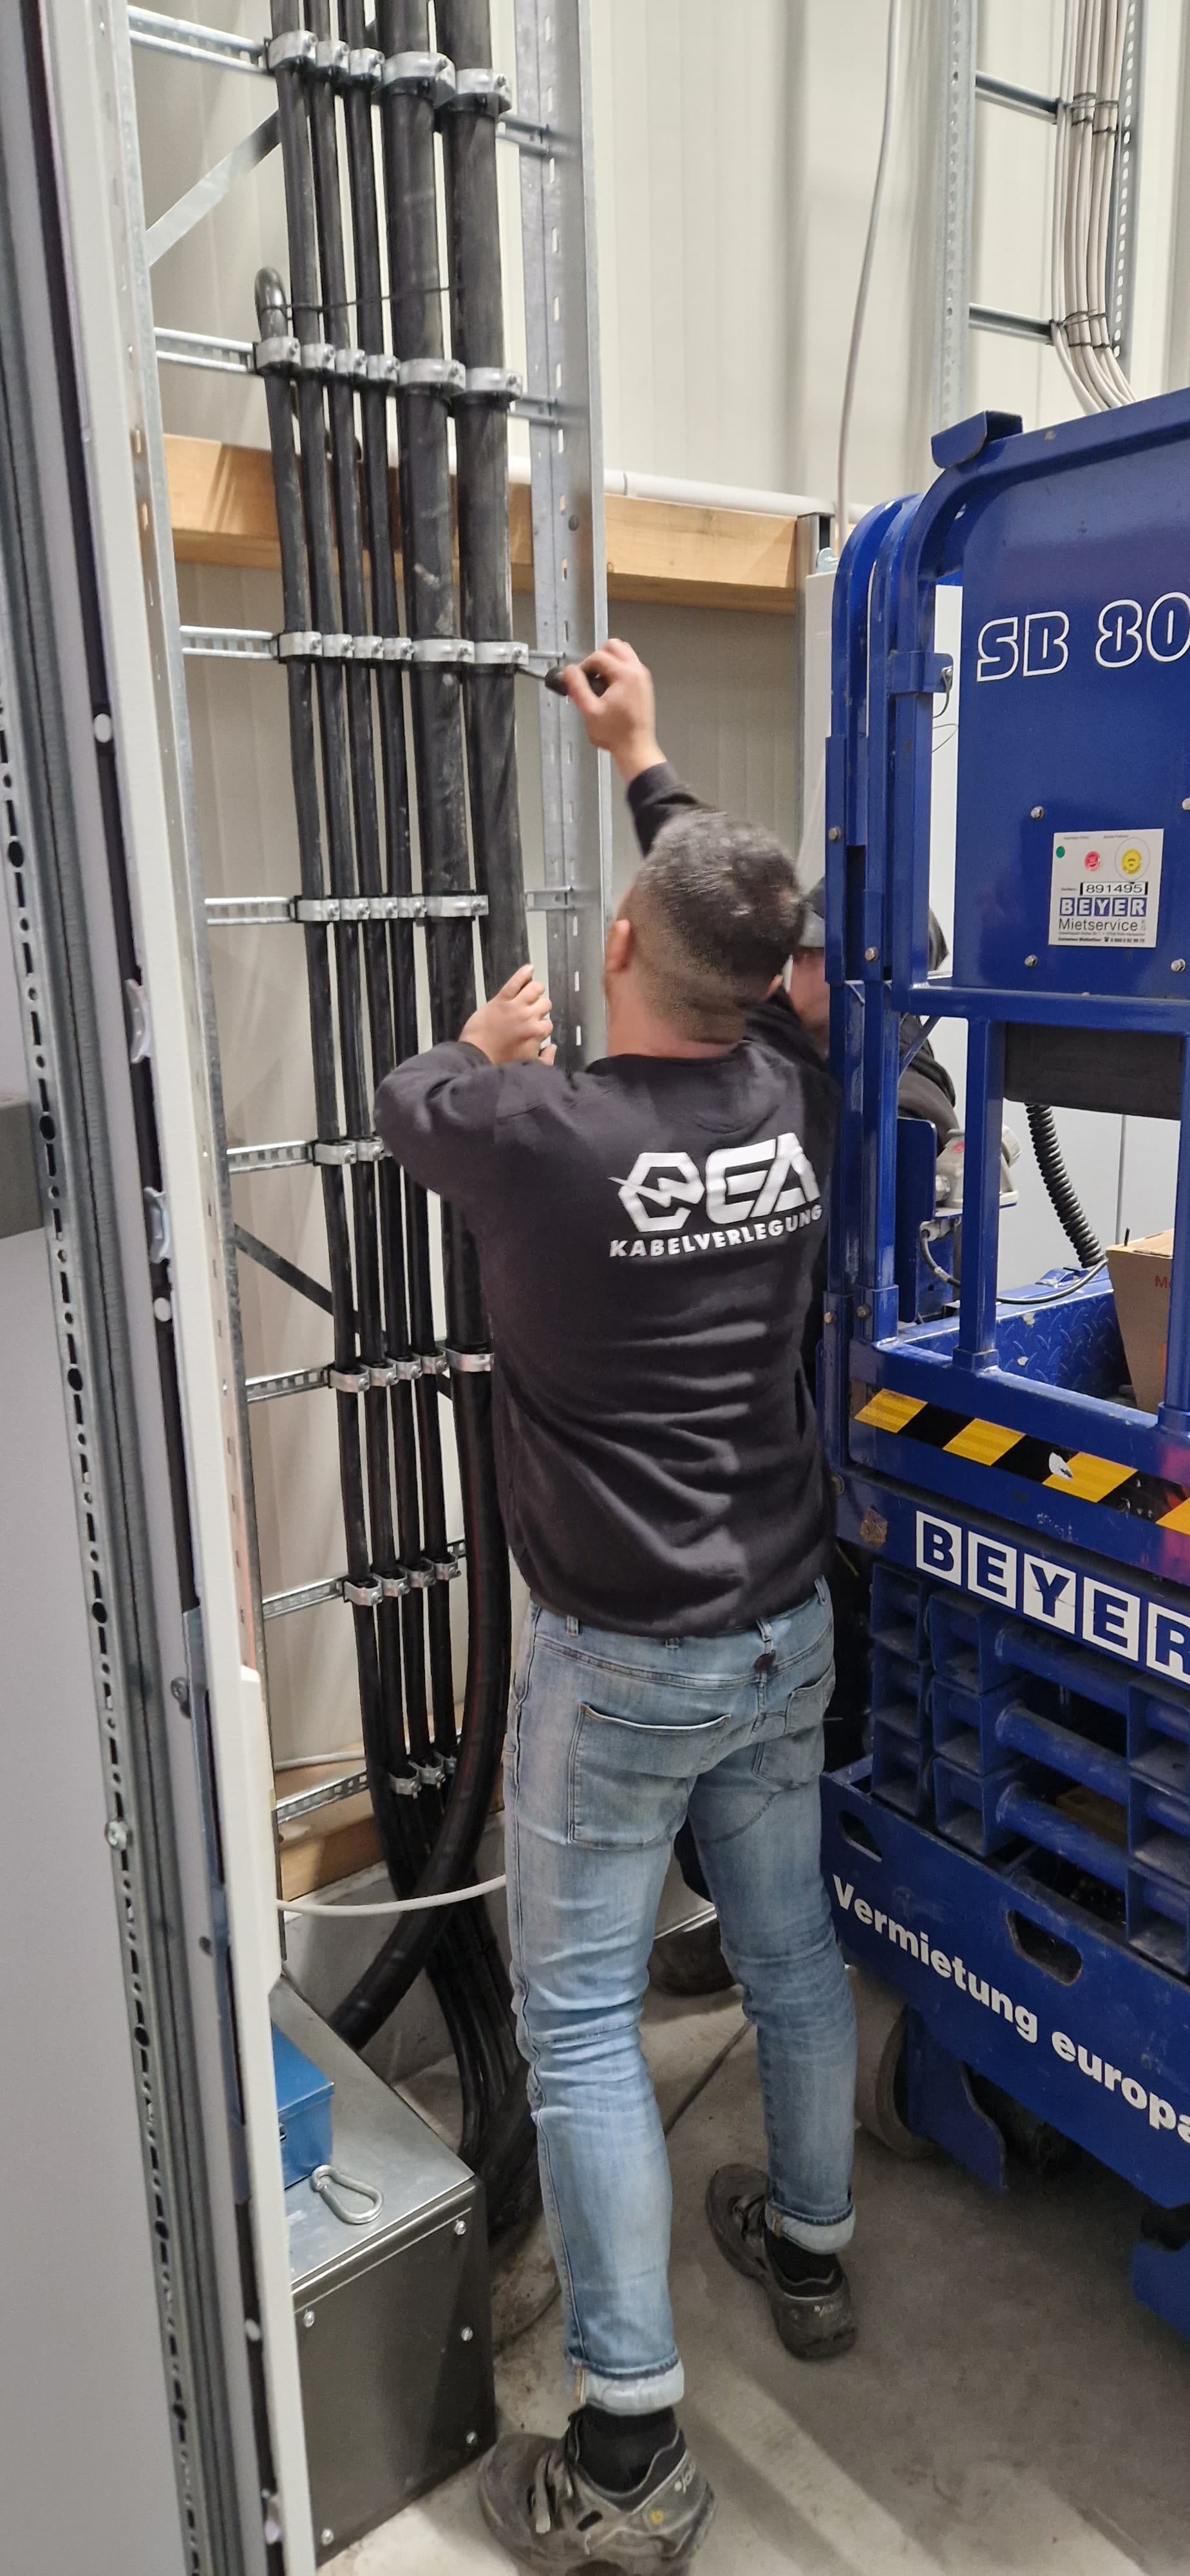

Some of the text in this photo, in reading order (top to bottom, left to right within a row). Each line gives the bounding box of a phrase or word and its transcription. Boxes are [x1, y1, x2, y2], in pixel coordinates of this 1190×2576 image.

[976, 592, 1190, 682] SB 80
[1061, 898, 1146, 916] BEYER
[1086, 884, 1143, 894] 891495
[1059, 918, 1138, 932] Mietservice
[609, 1204, 824, 1258] KABELVERLEGUNG
[1155, 1275, 1171, 1288] M
[920, 1513, 1190, 1682] BEYER
[832, 1875, 1038, 2044] Vermietung
